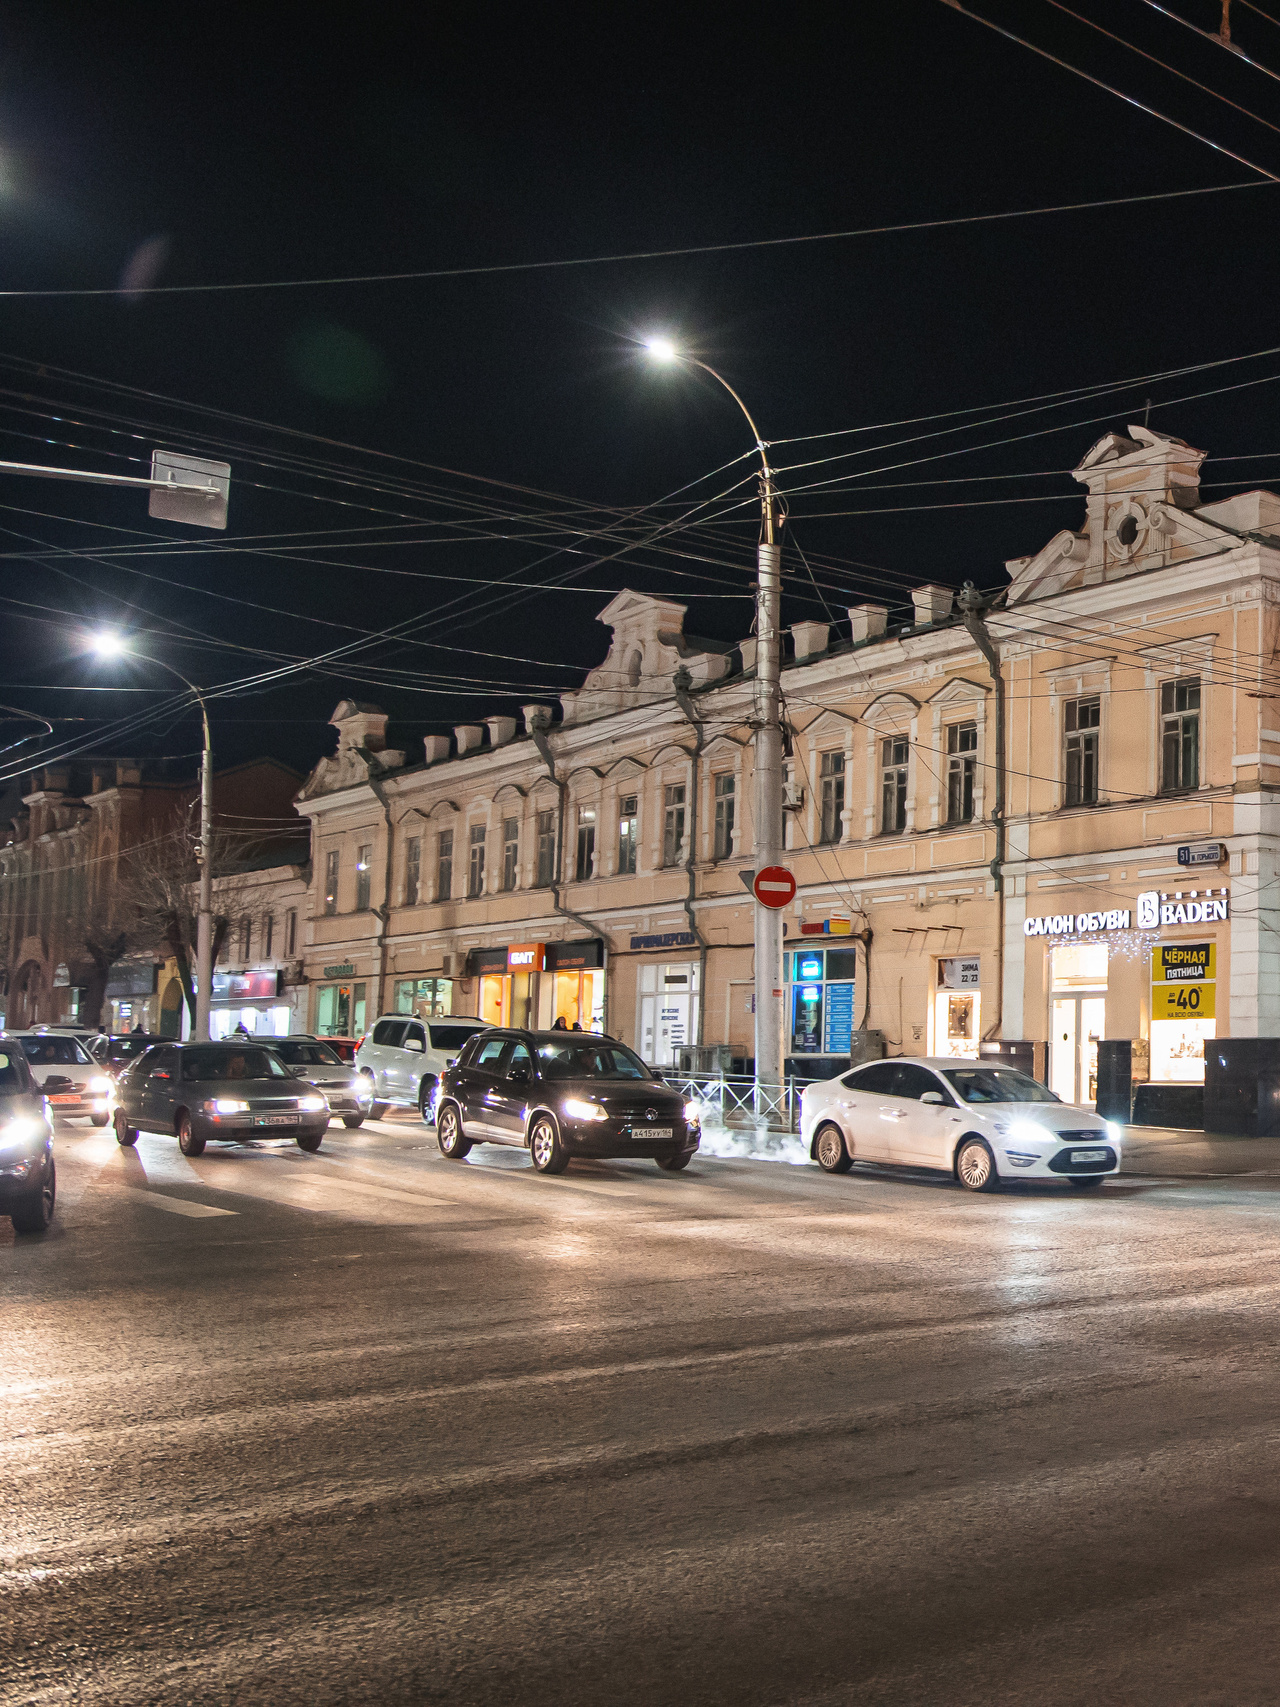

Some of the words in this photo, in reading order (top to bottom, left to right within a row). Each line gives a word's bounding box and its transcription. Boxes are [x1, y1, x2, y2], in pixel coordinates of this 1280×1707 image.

[1179, 850, 1189, 861] 51
[1161, 888, 1227, 901] SHOES
[1160, 900, 1228, 926] BADEN
[1024, 914, 1075, 936] САЛОН
[1077, 910, 1131, 932] ОБУВИ
[1164, 948, 1206, 964] ЧЁРНАЯ
[962, 964, 979, 972] ЗИМА
[1166, 965, 1204, 979] ПЯТНИЦА
